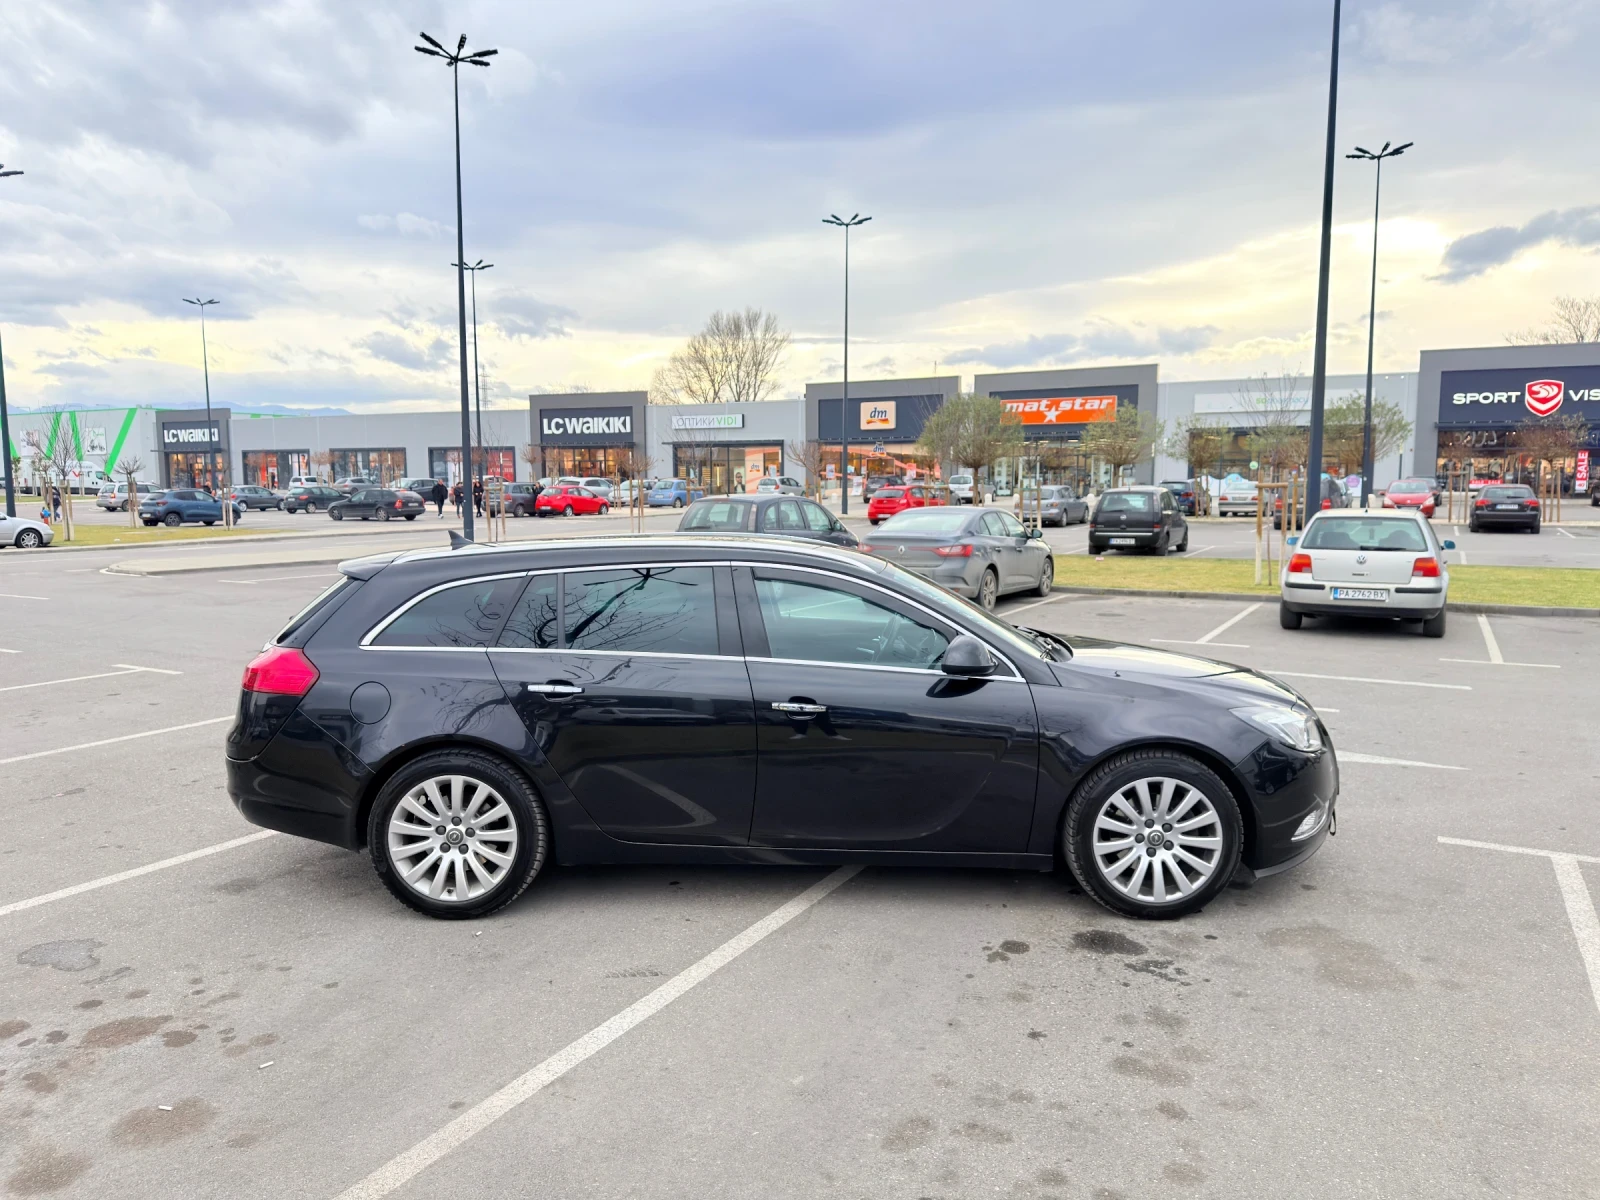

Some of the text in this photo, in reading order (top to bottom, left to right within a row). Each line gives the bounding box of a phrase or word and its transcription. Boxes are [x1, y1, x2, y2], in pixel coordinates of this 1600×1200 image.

[1453, 391, 1521, 405] SPORT
[870, 407, 887, 418] dm
[1005, 398, 1112, 413] mat star
[543, 418, 564, 434] LC
[716, 416, 737, 426] VIDI
[164, 429, 178, 443] LC
[1577, 450, 1588, 478] SALE
